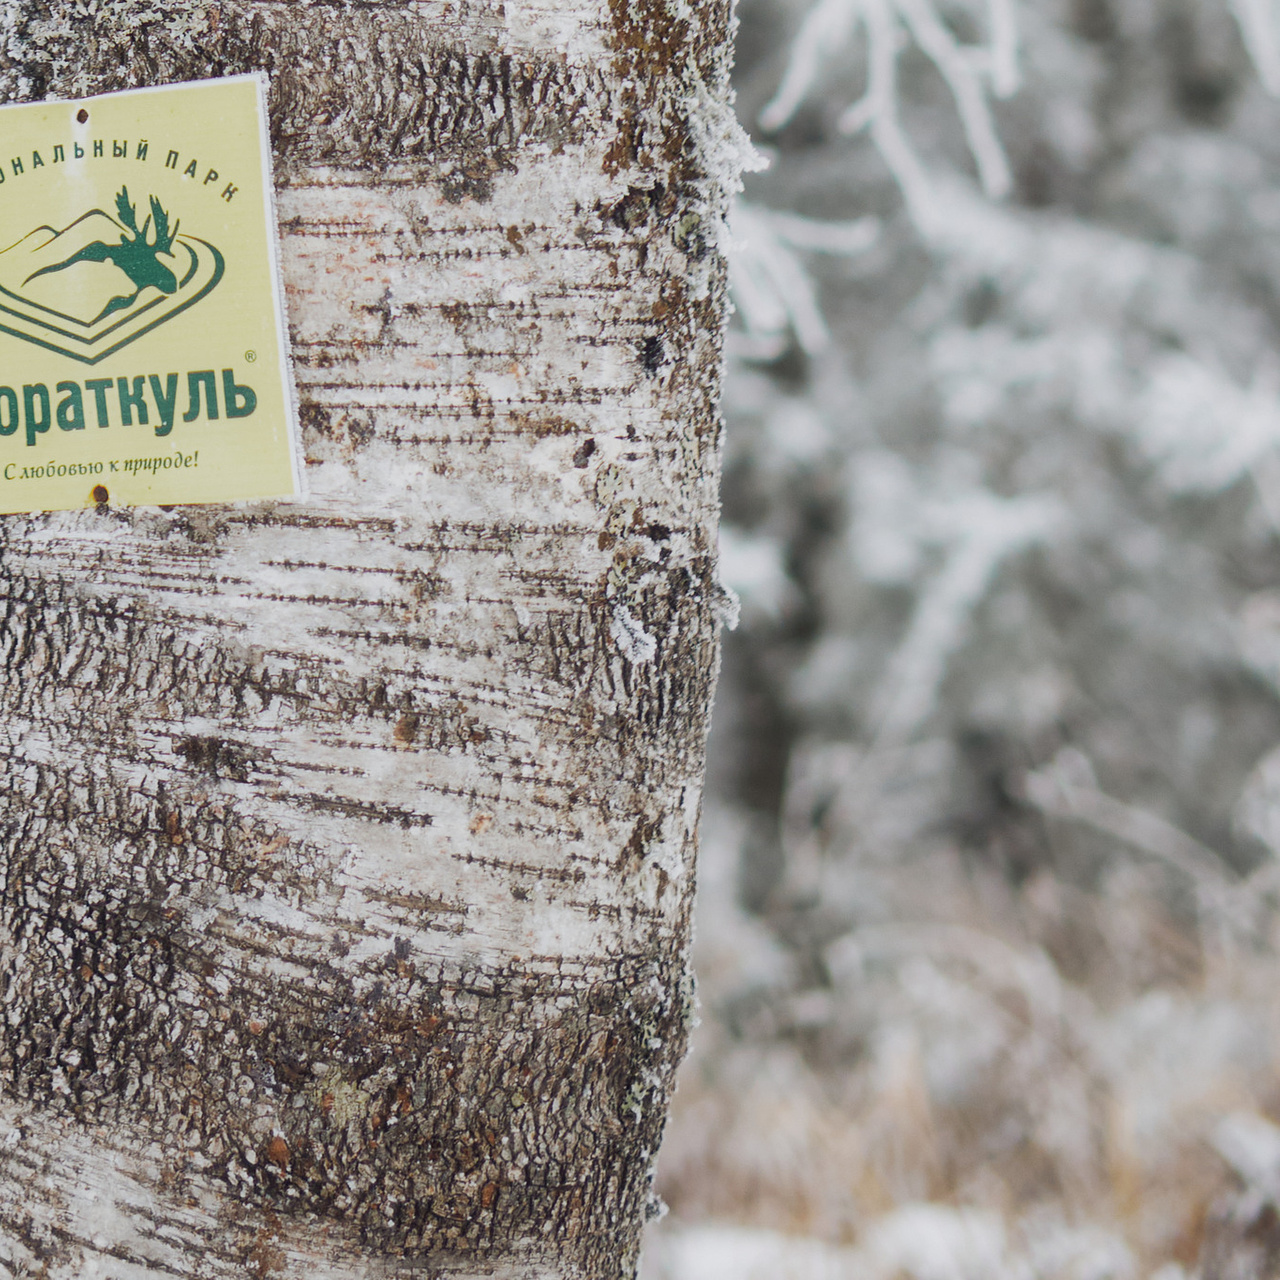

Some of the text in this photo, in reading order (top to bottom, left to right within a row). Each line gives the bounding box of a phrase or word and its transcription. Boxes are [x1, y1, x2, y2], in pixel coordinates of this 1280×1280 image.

[165, 149, 239, 203] ПАРК
[4, 450, 199, 480] С любовью к природе!
